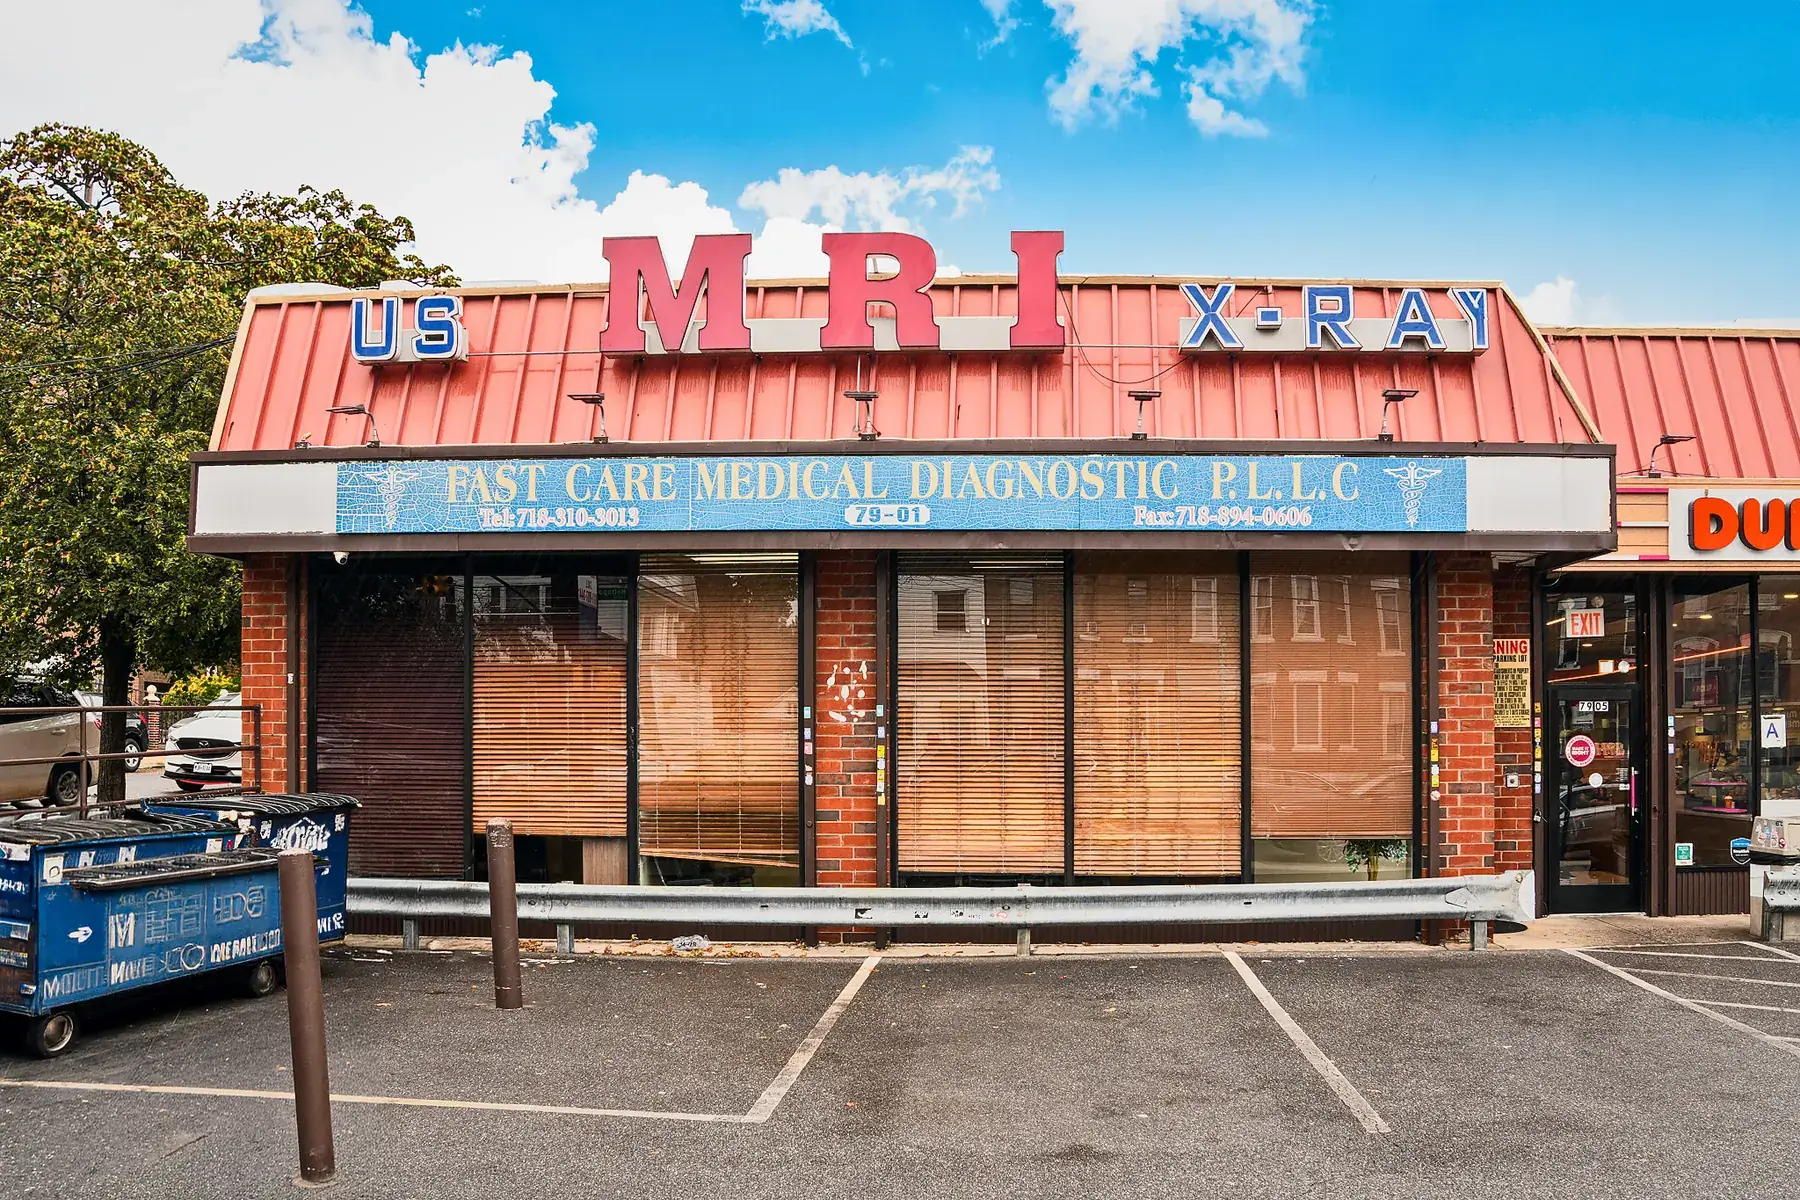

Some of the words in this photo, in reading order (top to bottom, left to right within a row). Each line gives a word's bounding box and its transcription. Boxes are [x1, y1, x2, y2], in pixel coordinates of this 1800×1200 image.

[351, 296, 462, 361] US
[600, 231, 1065, 353] MRI
[1179, 282, 1489, 350] X-RAY
[447, 464, 546, 503] FAST
[565, 463, 678, 501] CARE
[695, 461, 889, 500] MEDICAL
[909, 460, 1179, 500] DIAGNOSTIC
[855, 506, 921, 523] 79-01
[1688, 496, 1800, 551] DU
[1570, 612, 1601, 636] EXIT
[1493, 640, 1528, 655] NING
[1518, 654, 1528, 663] LOT
[1580, 701, 1609, 711] 7905
[1766, 722, 1779, 739] A
